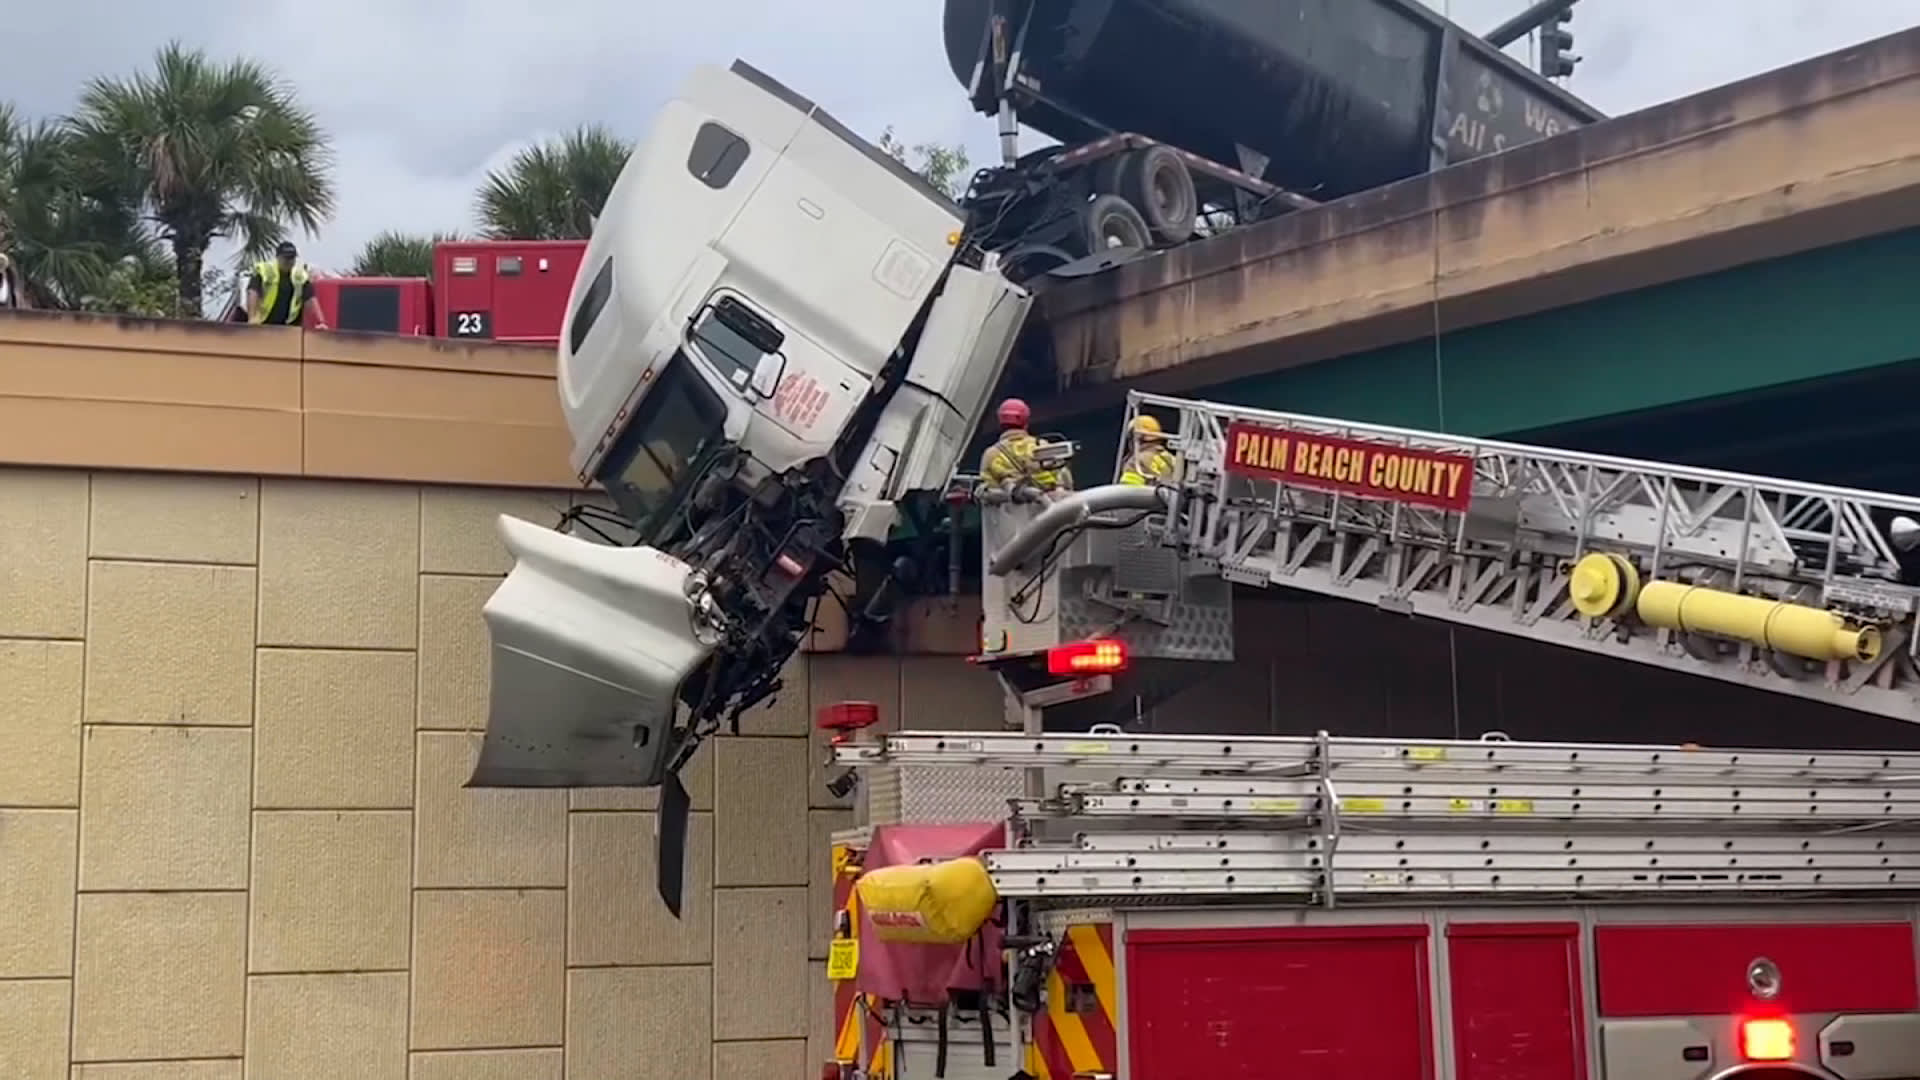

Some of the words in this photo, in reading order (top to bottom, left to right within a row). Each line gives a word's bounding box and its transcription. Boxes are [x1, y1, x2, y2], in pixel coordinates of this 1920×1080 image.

[1448, 112, 1486, 152] All
[457, 312, 482, 334] 23
[1234, 431, 1289, 472] PALM
[1293, 440, 1365, 484] BEACH
[1368, 452, 1464, 499] COUNTY
